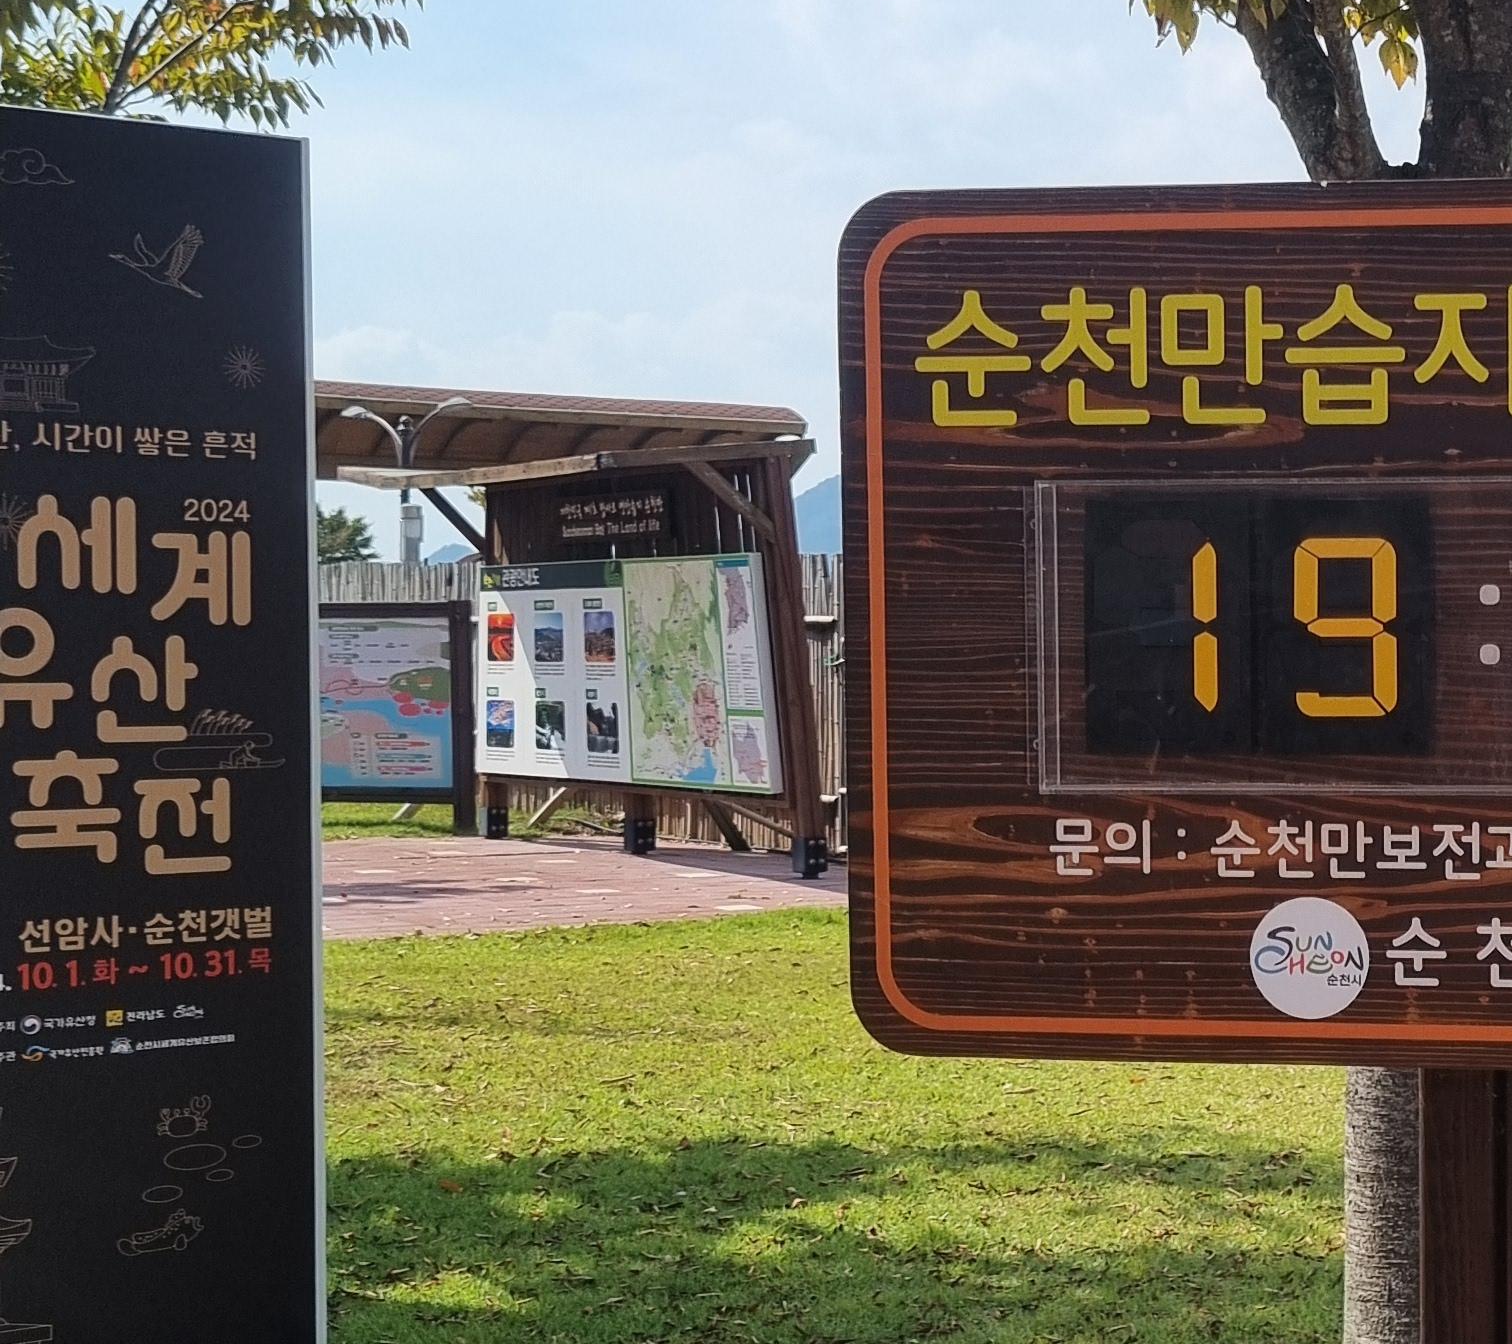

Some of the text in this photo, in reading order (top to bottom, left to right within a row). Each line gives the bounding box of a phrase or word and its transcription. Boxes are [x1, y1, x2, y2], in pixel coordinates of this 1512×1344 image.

[32, 422, 123, 454] 시간이
[134, 427, 192, 458] 쌓은
[203, 430, 257, 461] 흔적
[183, 499, 251, 523] 2024
[17, 494, 252, 626] 세계
[0, 608, 198, 743] 유산
[10, 750, 232, 875] 축전
[1050, 819, 1151, 876] 문의
[17, 961, 57, 991] 10.
[66, 959, 86, 987] 1.
[92, 957, 120, 985] 화
[160, 952, 198, 980] 10.
[204, 949, 243, 978] 31.
[248, 947, 273, 974] 목
[1326, 973, 1362, 987] 순천시
